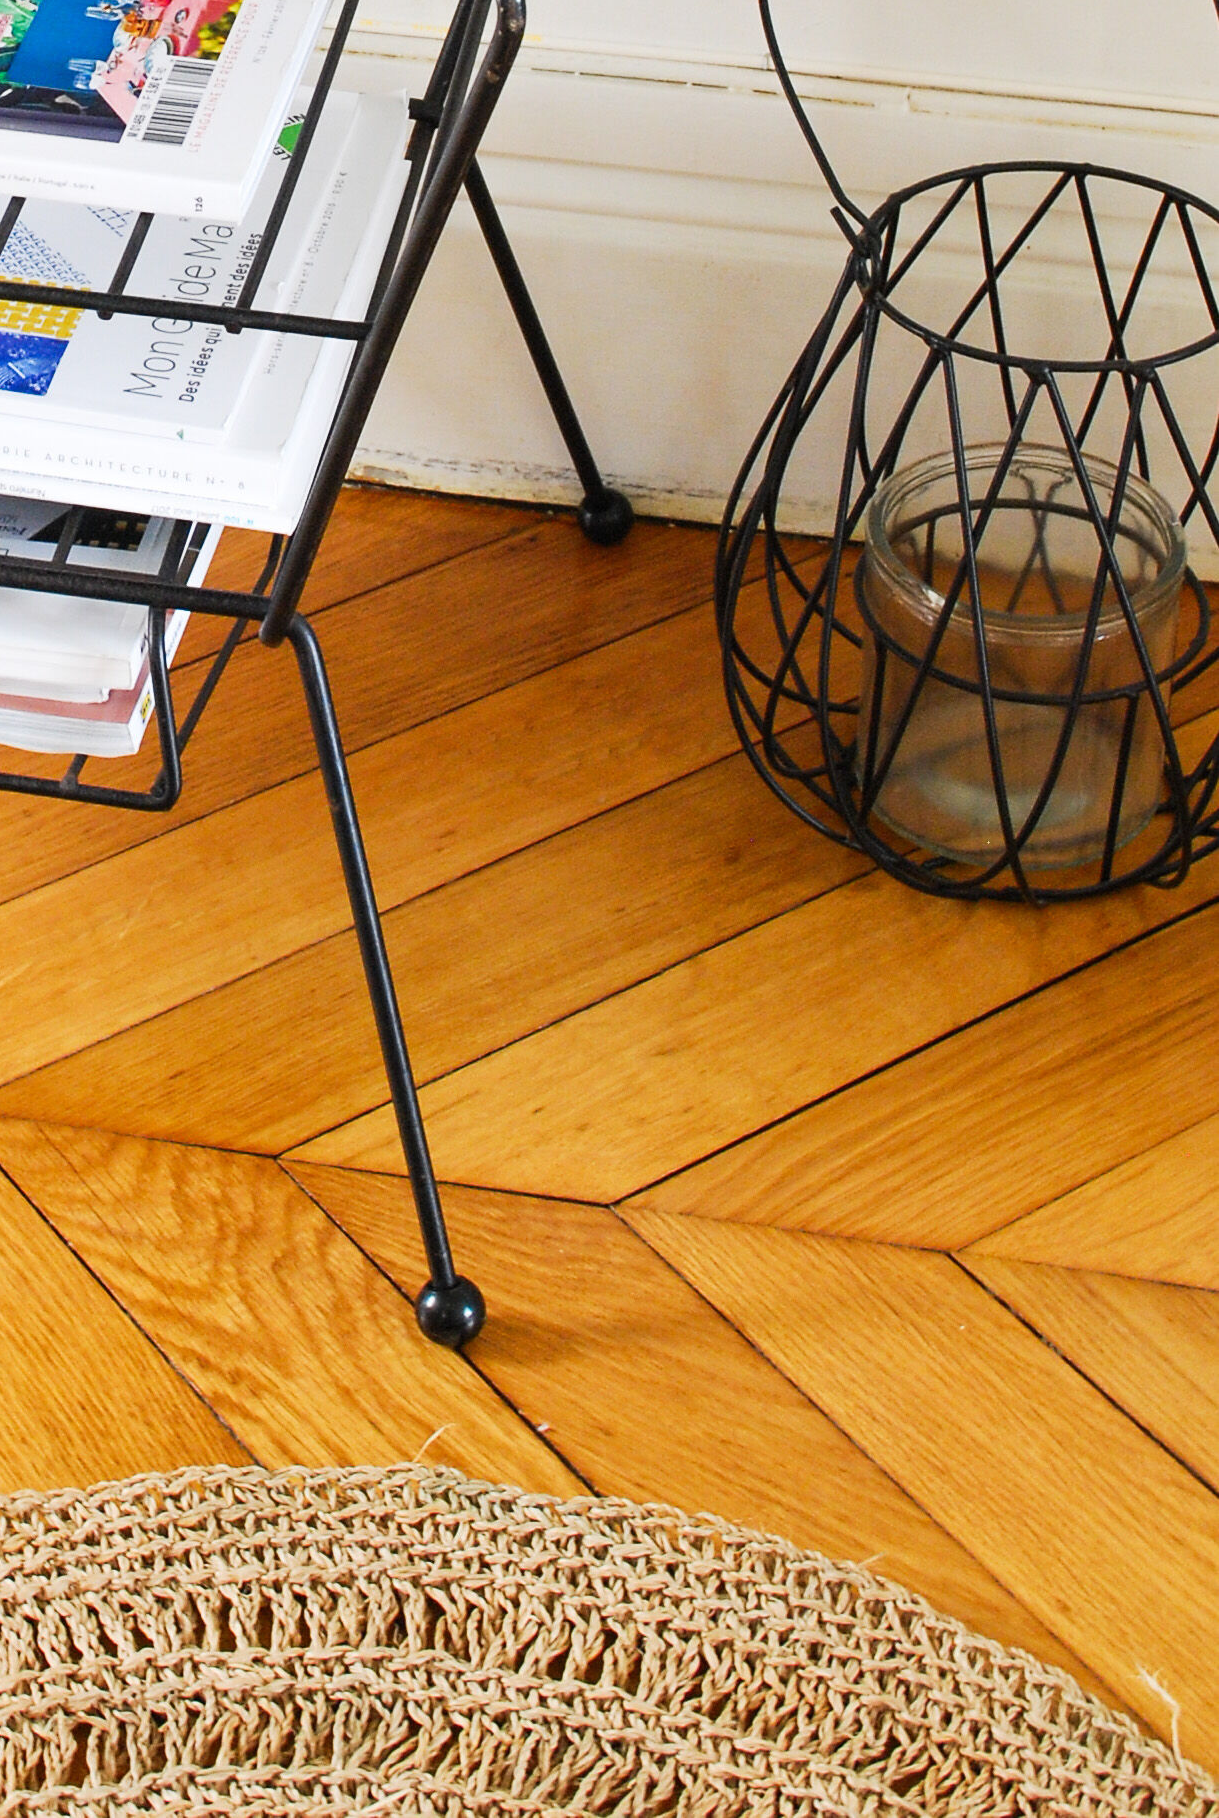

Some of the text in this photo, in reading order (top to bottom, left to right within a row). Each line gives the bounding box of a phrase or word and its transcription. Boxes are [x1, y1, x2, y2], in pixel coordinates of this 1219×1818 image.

[195, 196, 204, 213] 126
[308, 222, 328, 254] Octobre
[323, 202, 337, 220] 2016
[237, 233, 263, 262] idées
[230, 262, 250, 282] des
[151, 265, 217, 334] Gide
[206, 327, 223, 346] qui
[123, 340, 185, 398] Mon
[187, 345, 216, 378] idées
[178, 380, 200, 403] Des
[44, 450, 193, 484] ARCHITECTURE
[238, 480, 247, 491] 8
[9, 484, 47, 498] Numéro
[150, 505, 174, 516] 2017
